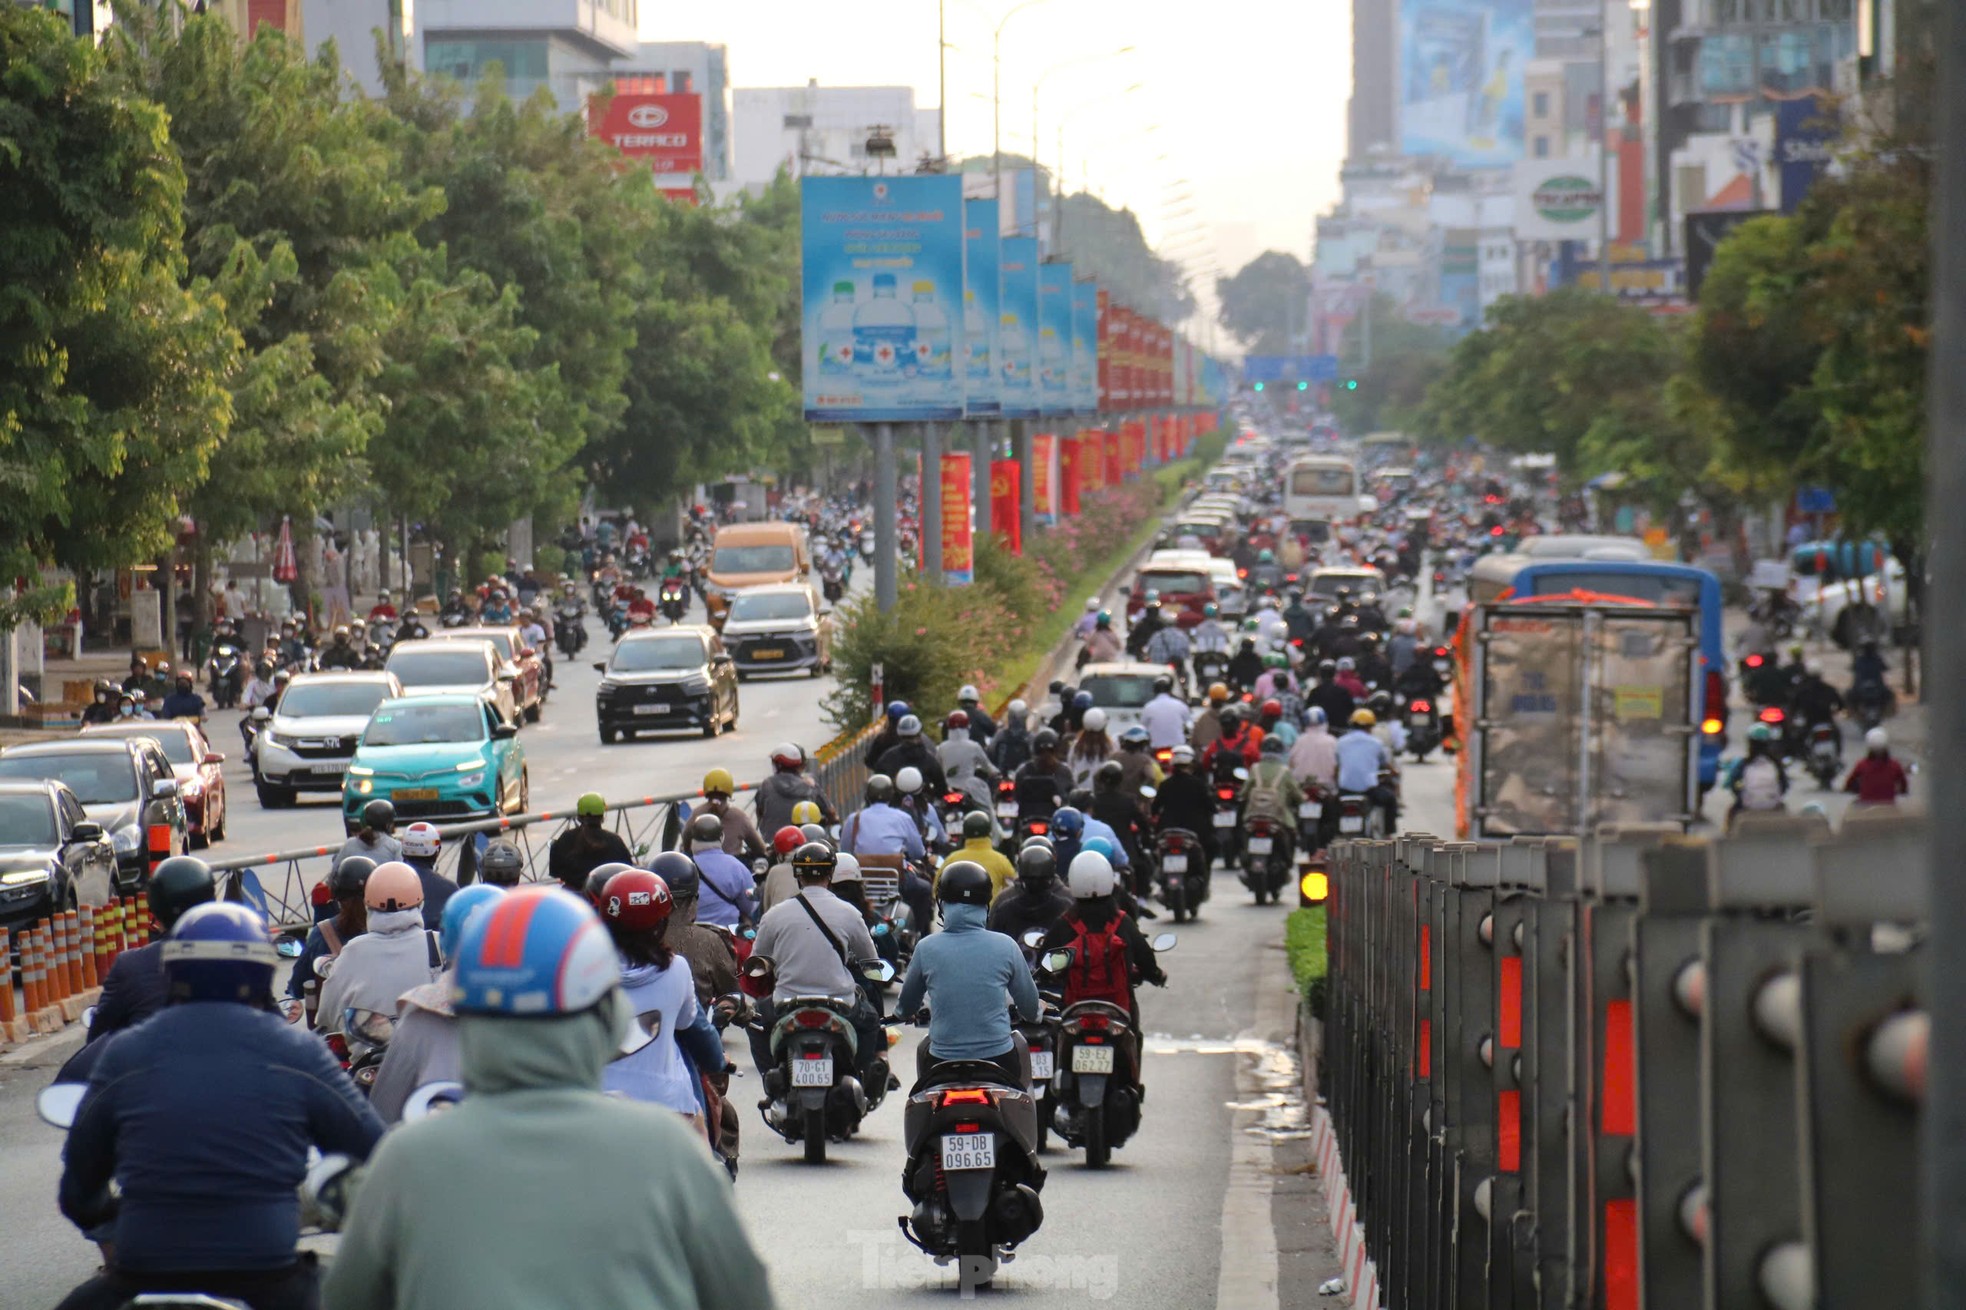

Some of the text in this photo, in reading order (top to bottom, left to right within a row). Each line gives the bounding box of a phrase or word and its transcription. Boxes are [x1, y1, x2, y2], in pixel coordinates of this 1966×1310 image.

[613, 133, 687, 147] TERACO
[799, 1061, 826, 1072] 70-G1
[795, 1073, 830, 1085] 400.65
[949, 1135, 987, 1152] 59-DB
[946, 1152, 991, 1168] 096.65
